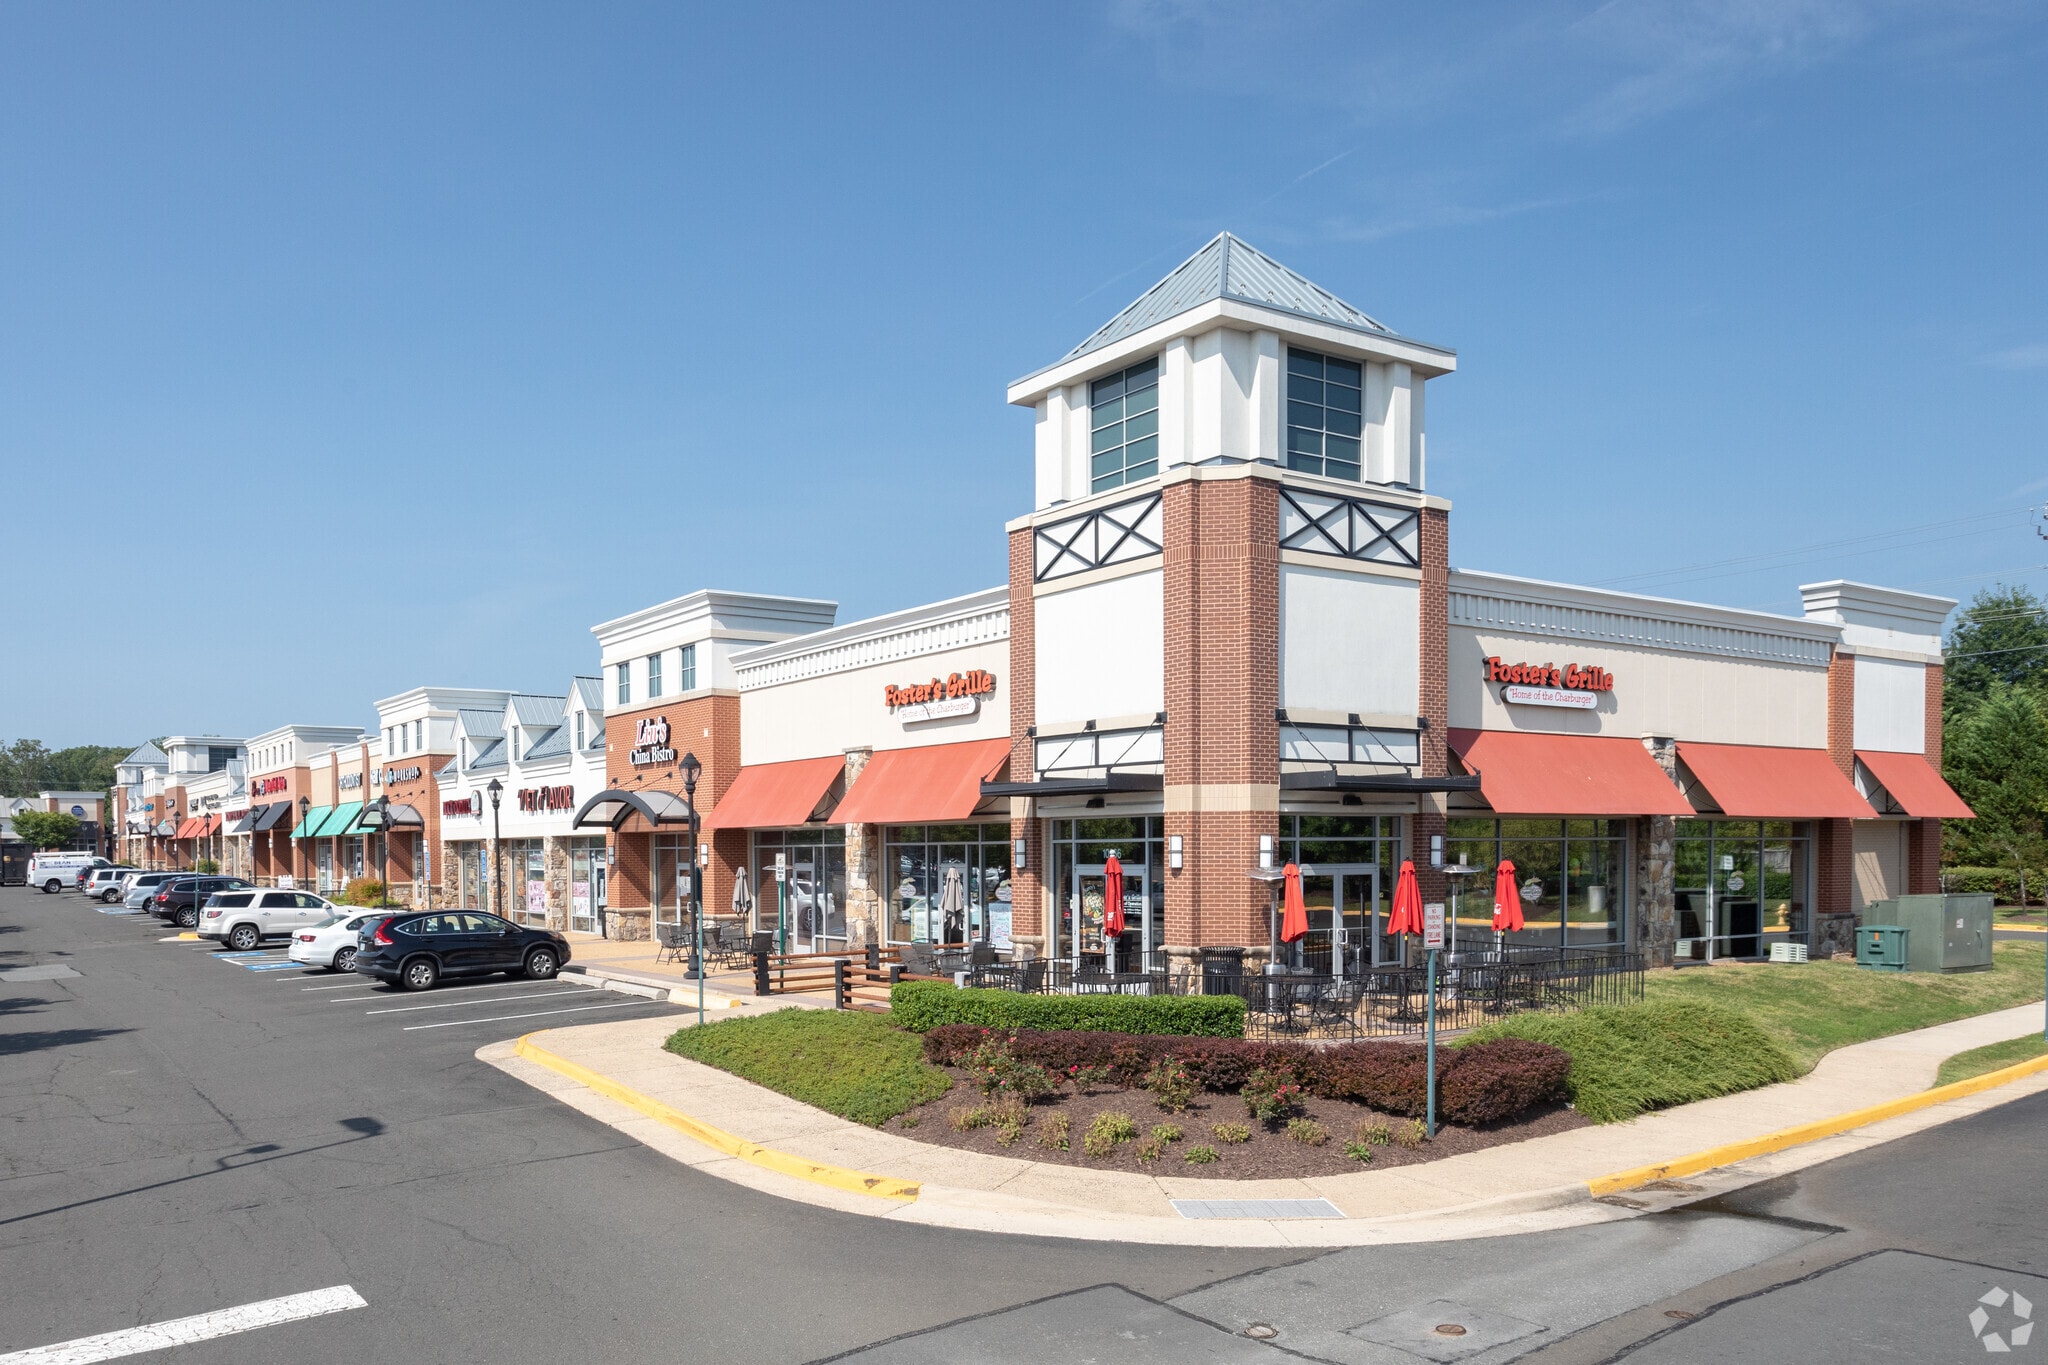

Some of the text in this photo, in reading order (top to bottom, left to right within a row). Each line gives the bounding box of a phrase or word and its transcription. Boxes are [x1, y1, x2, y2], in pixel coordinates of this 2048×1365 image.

[1487, 656, 1613, 691] Foster's Grille
[884, 669, 992, 706] Foster's Grille
[1533, 690, 1542, 700] of
[1542, 690, 1553, 701] the
[630, 745, 674, 765] China Bistro
[517, 788, 536, 811] VIET
